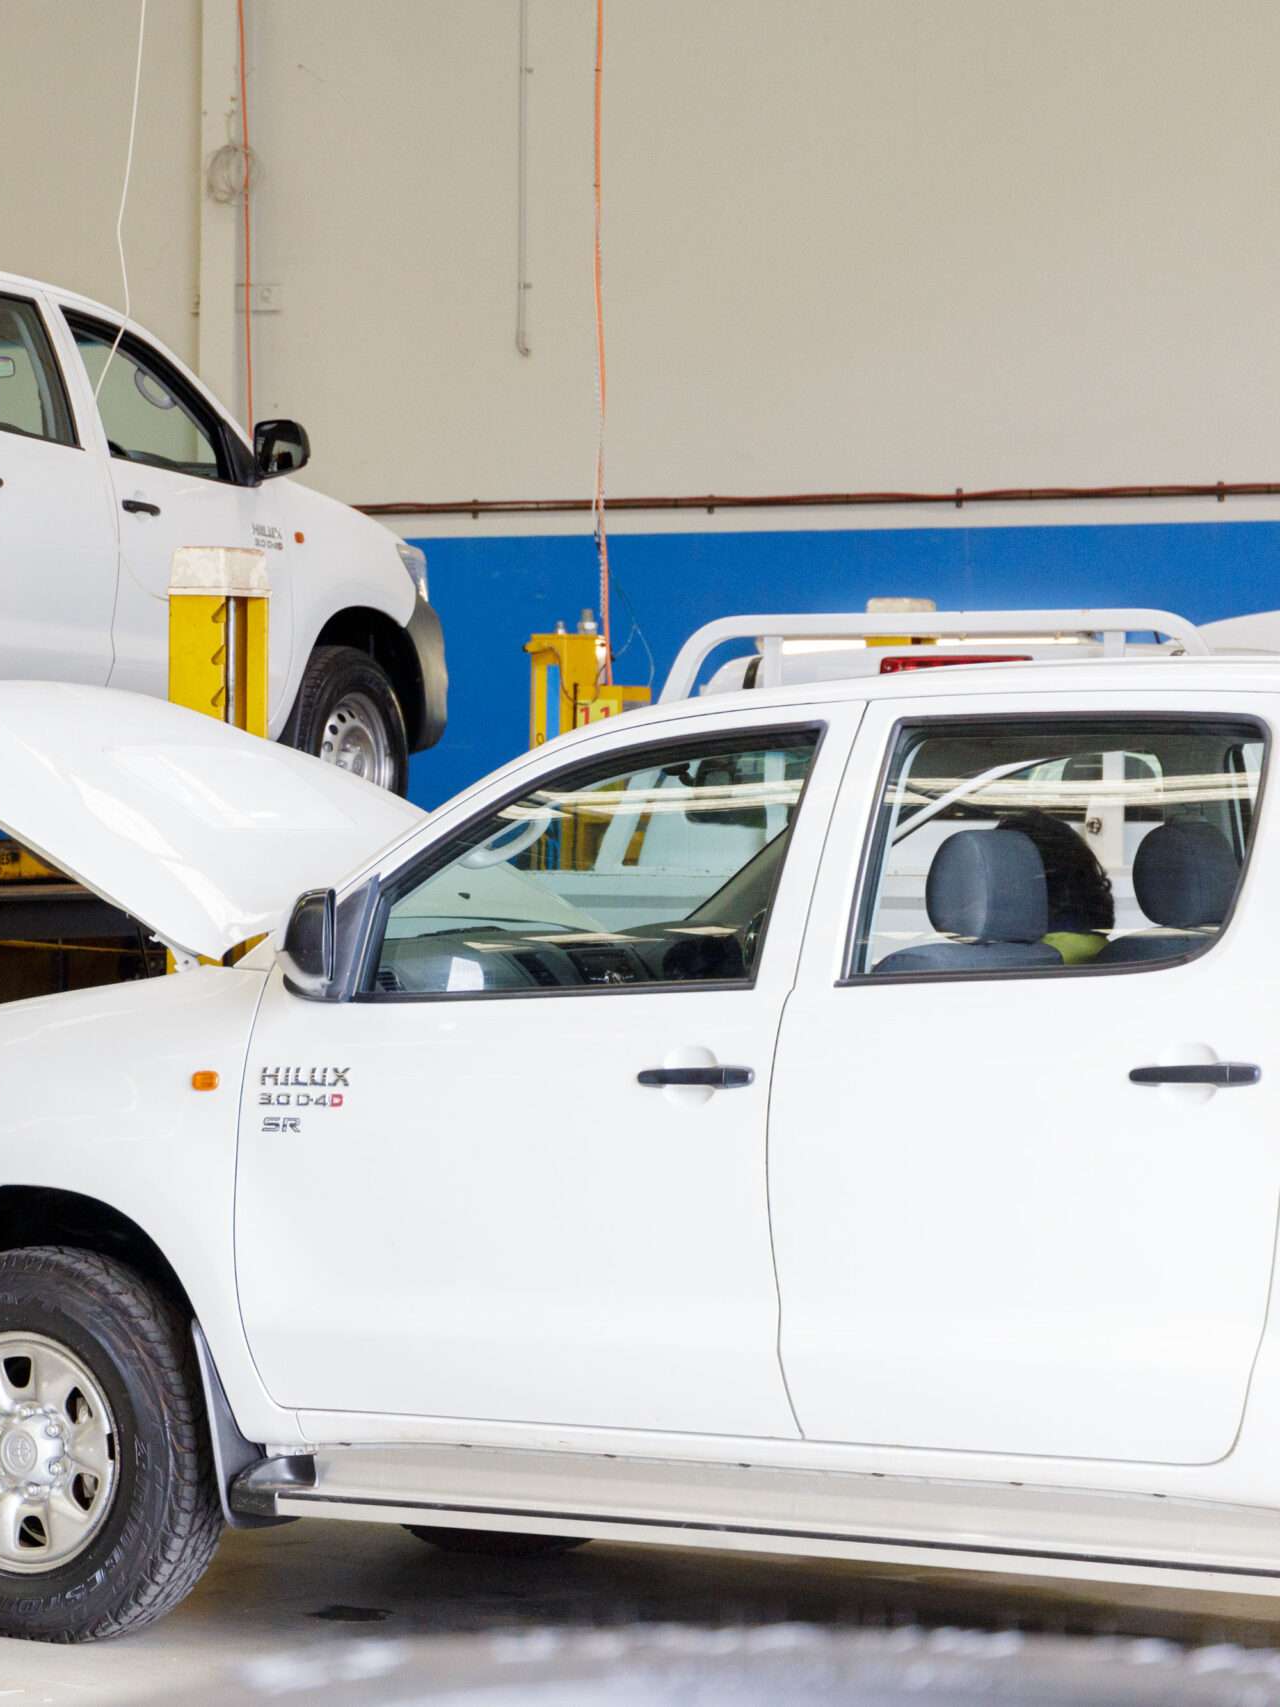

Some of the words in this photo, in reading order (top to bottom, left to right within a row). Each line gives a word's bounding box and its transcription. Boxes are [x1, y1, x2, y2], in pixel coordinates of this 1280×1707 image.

[260, 1066, 351, 1087] HILUX
[258, 1092, 291, 1106] 3.0
[261, 1116, 302, 1133] SR
